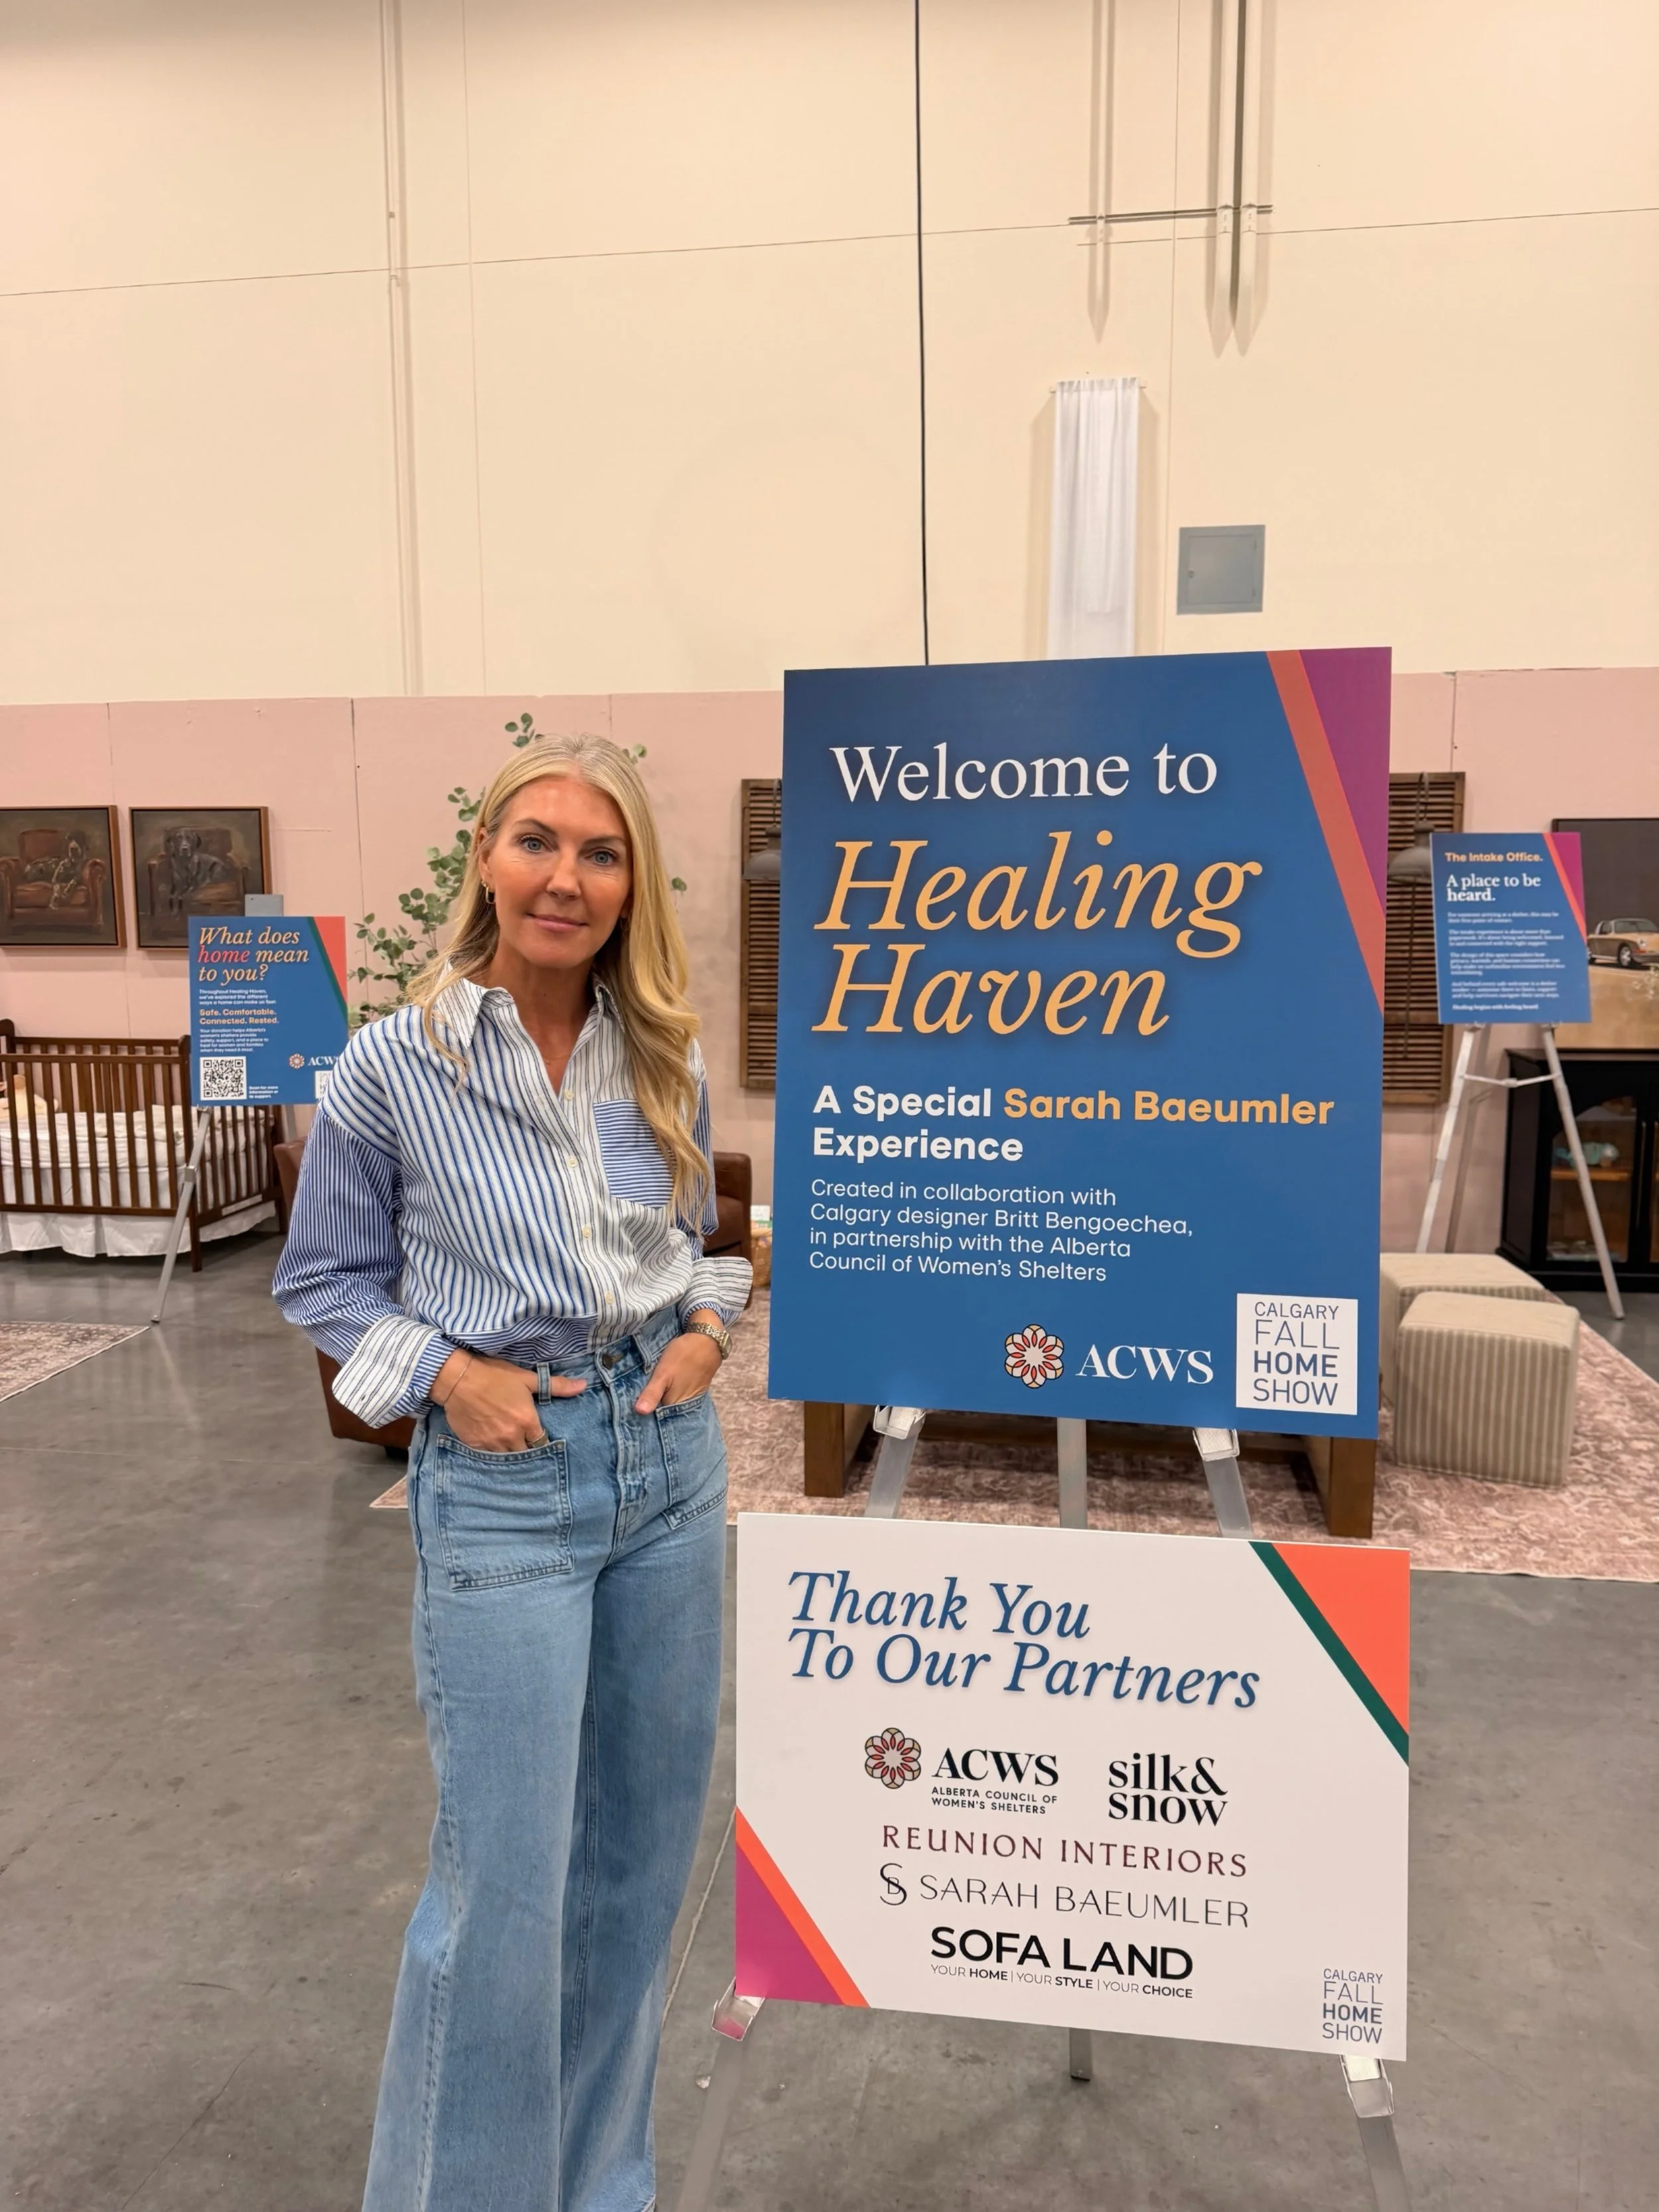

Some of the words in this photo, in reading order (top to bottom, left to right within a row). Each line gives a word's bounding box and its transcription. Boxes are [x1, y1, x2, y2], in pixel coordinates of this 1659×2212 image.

[830, 743, 1129, 802] Welcome
[1153, 743, 1216, 794] to
[1445, 852, 1467, 861] The
[1469, 852, 1504, 861] Intake
[1506, 852, 1543, 861] Office.
[814, 830, 1262, 959] Healing
[1446, 875, 1458, 887] A
[1462, 873, 1500, 890] place
[1504, 876, 1519, 887] to
[1522, 873, 1541, 887] be
[1447, 888, 1496, 901] heard.
[200, 926, 253, 945] What
[258, 926, 300, 944] does
[198, 945, 250, 963] home
[255, 948, 309, 962] mean
[199, 966, 217, 981] to
[221, 964, 268, 985] you?
[812, 944, 1169, 1035] Haven
[308, 1056, 339, 1067] ACW
[813, 1086, 841, 1113] A
[853, 1086, 991, 1122] Special
[1004, 1088, 1120, 1120] Sarah
[1135, 1091, 1334, 1124] Baeumler
[814, 1128, 1023, 1163] Experience
[812, 1179, 893, 1198] Created
[901, 1182, 916, 1199] in
[924, 1184, 1063, 1203] collaboration
[1071, 1188, 1116, 1205] with
[811, 1203, 891, 1226] Calgary
[898, 1207, 988, 1228] designer
[995, 1210, 1038, 1228] Britt
[1046, 1212, 1192, 1236] Bengoechea,
[811, 1228, 826, 1244] in
[833, 1231, 952, 1252] partnership
[959, 1234, 1001, 1251] with
[1009, 1236, 1043, 1253] the
[1050, 1237, 1130, 1256] Alberta
[810, 1252, 885, 1271] Council
[893, 1256, 912, 1272] of
[918, 1256, 1011, 1276] Women’s
[1019, 1260, 1106, 1281] Shelters
[1255, 1302, 1338, 1319] CALGARY
[1256, 1319, 1339, 1349] FALL
[1076, 1345, 1213, 1384] ACWS
[1254, 1351, 1337, 1377] HOME
[1254, 1378, 1338, 1406] SHOW
[788, 1570, 967, 1631] Thank
[989, 1583, 1090, 1639] You
[788, 1628, 853, 1679] To
[877, 1634, 991, 1688] Our
[1003, 1642, 1260, 1708] Partners
[932, 1748, 1058, 1786] ACWS
[1109, 1753, 1227, 1795] silk&
[932, 1787, 979, 1797] ALBERTA
[985, 1791, 1037, 1802] COUNCIL
[932, 1798, 985, 1809] WOMEN'S
[991, 1803, 1045, 1814] SHELTERS
[1109, 1793, 1227, 1826] snow
[883, 1826, 1041, 1860] REUNION
[1062, 1840, 1246, 1877] INTERIORS
[921, 1875, 1037, 1909] SARAH
[1056, 1886, 1248, 1927] BAEUMLER
[932, 1927, 1050, 1968] SOFA
[1064, 1938, 1192, 1980] LAND
[970, 1968, 1007, 1980] HOME
[1017, 1973, 1051, 1984] YOUR
[1056, 1977, 1092, 1988] STYLE
[1104, 1981, 1138, 1992] YOUR
[1143, 1985, 1192, 1998] CHOICE
[1324, 1968, 1382, 1984] CALGARY
[1325, 1981, 1383, 2004] FALL
[1323, 2003, 1382, 2024] HOME
[1323, 2023, 1382, 2043] SHOW
